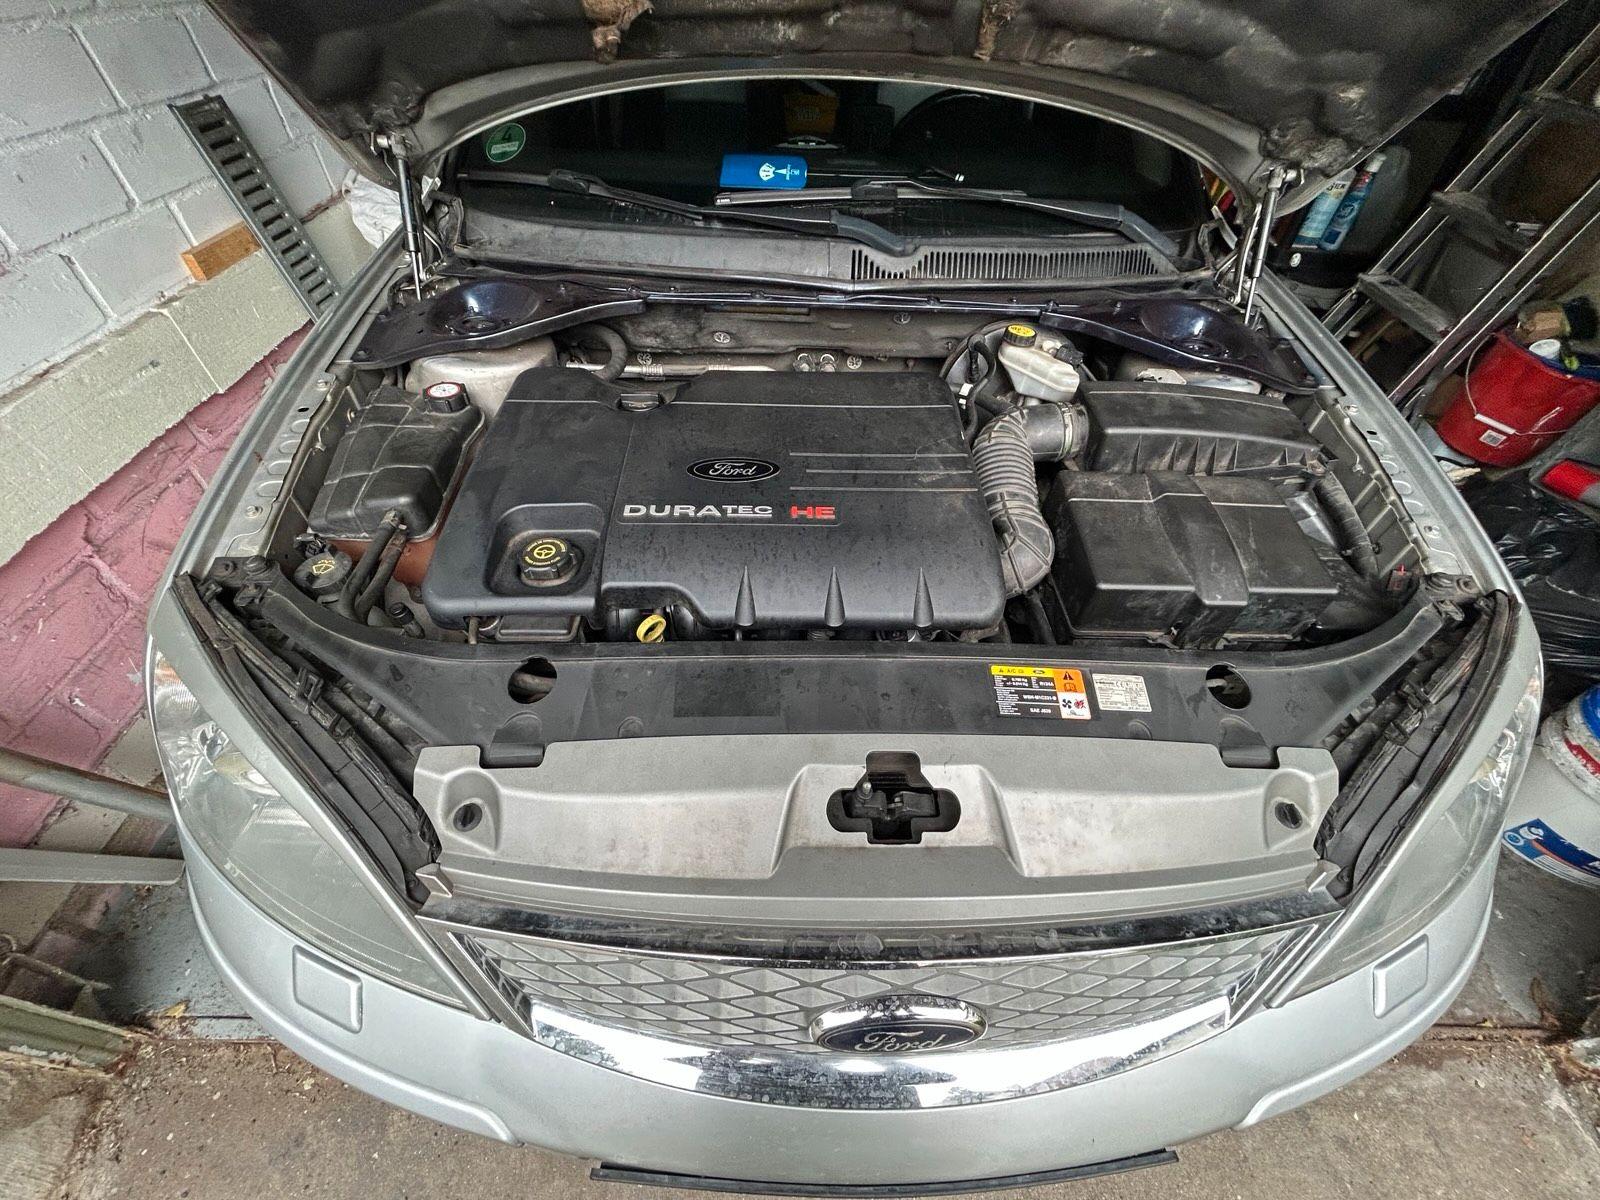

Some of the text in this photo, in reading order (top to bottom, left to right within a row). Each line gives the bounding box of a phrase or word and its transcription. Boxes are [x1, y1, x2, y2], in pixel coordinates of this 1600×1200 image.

[709, 462, 757, 476] Ford
[623, 504, 836, 519] DURATEC HE
[855, 1030, 947, 1051] Ford
